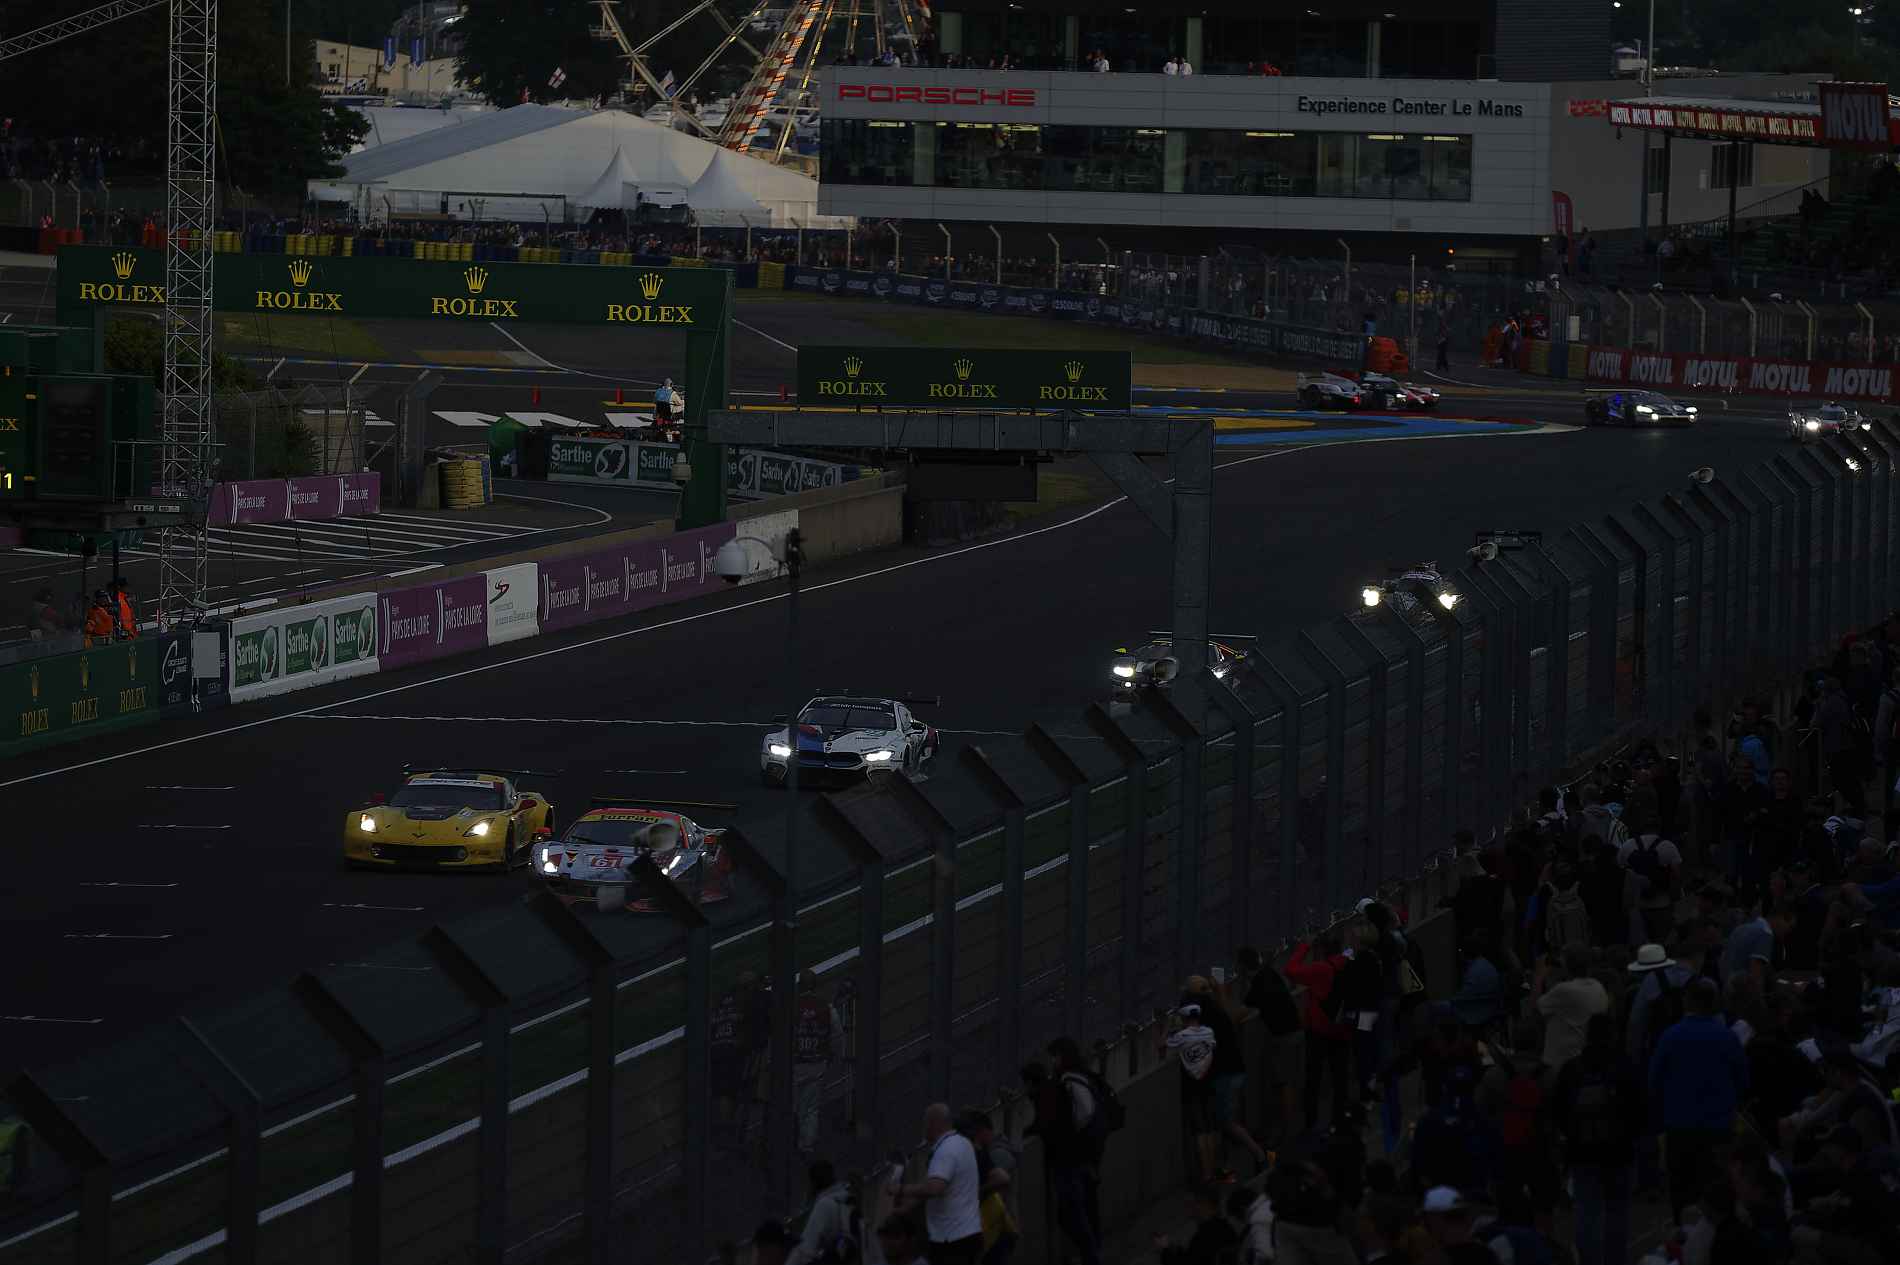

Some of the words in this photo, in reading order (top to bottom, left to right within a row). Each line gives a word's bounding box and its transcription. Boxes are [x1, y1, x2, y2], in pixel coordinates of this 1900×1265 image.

[839, 84, 1036, 106] PORSCHE
[1298, 97, 1386, 116] Experience
[1393, 98, 1447, 115] Center
[1453, 99, 1472, 115] Le
[1479, 99, 1522, 117] Mans
[1611, 107, 1631, 124] MOTUL
[1632, 108, 1653, 125] MOTUL
[1825, 92, 1888, 141] MOTUL
[1654, 109, 1674, 127] MOTUL
[1676, 111, 1697, 128] MOTUL
[1698, 112, 1719, 130] MOTUL
[1721, 114, 1743, 132] MOTUL
[1745, 116, 1767, 134] MOTUL
[1769, 117, 1791, 136] MOTUL
[1792, 119, 1816, 137] MOTUL
[79, 282, 168, 304] ROLEX
[255, 291, 344, 311] ROLEX
[431, 297, 520, 317] ROLEX
[606, 304, 695, 324] ROLEX
[1588, 351, 1621, 380] MOTUL
[1630, 355, 1674, 384] MOTUL
[1683, 359, 1739, 386] MOTUL
[1750, 362, 1812, 392] MOTUL
[1825, 367, 1892, 397] MOTUL
[818, 381, 888, 396] ROLEX
[929, 383, 998, 398] ROLEX
[1040, 385, 1109, 400] ROLEX
[551, 443, 592, 463] Sarthe
[457, 608, 463, 628] DE
[464, 605, 469, 625] LA
[336, 617, 357, 645] Sarthe
[404, 617, 410, 638] DE
[411, 616, 417, 637] LA
[288, 627, 309, 655] Sarthe
[236, 638, 259, 666] Sarthe
[120, 686, 146, 712] ROLEX
[72, 697, 98, 724] ROLEX
[22, 707, 49, 736] ROLEX
